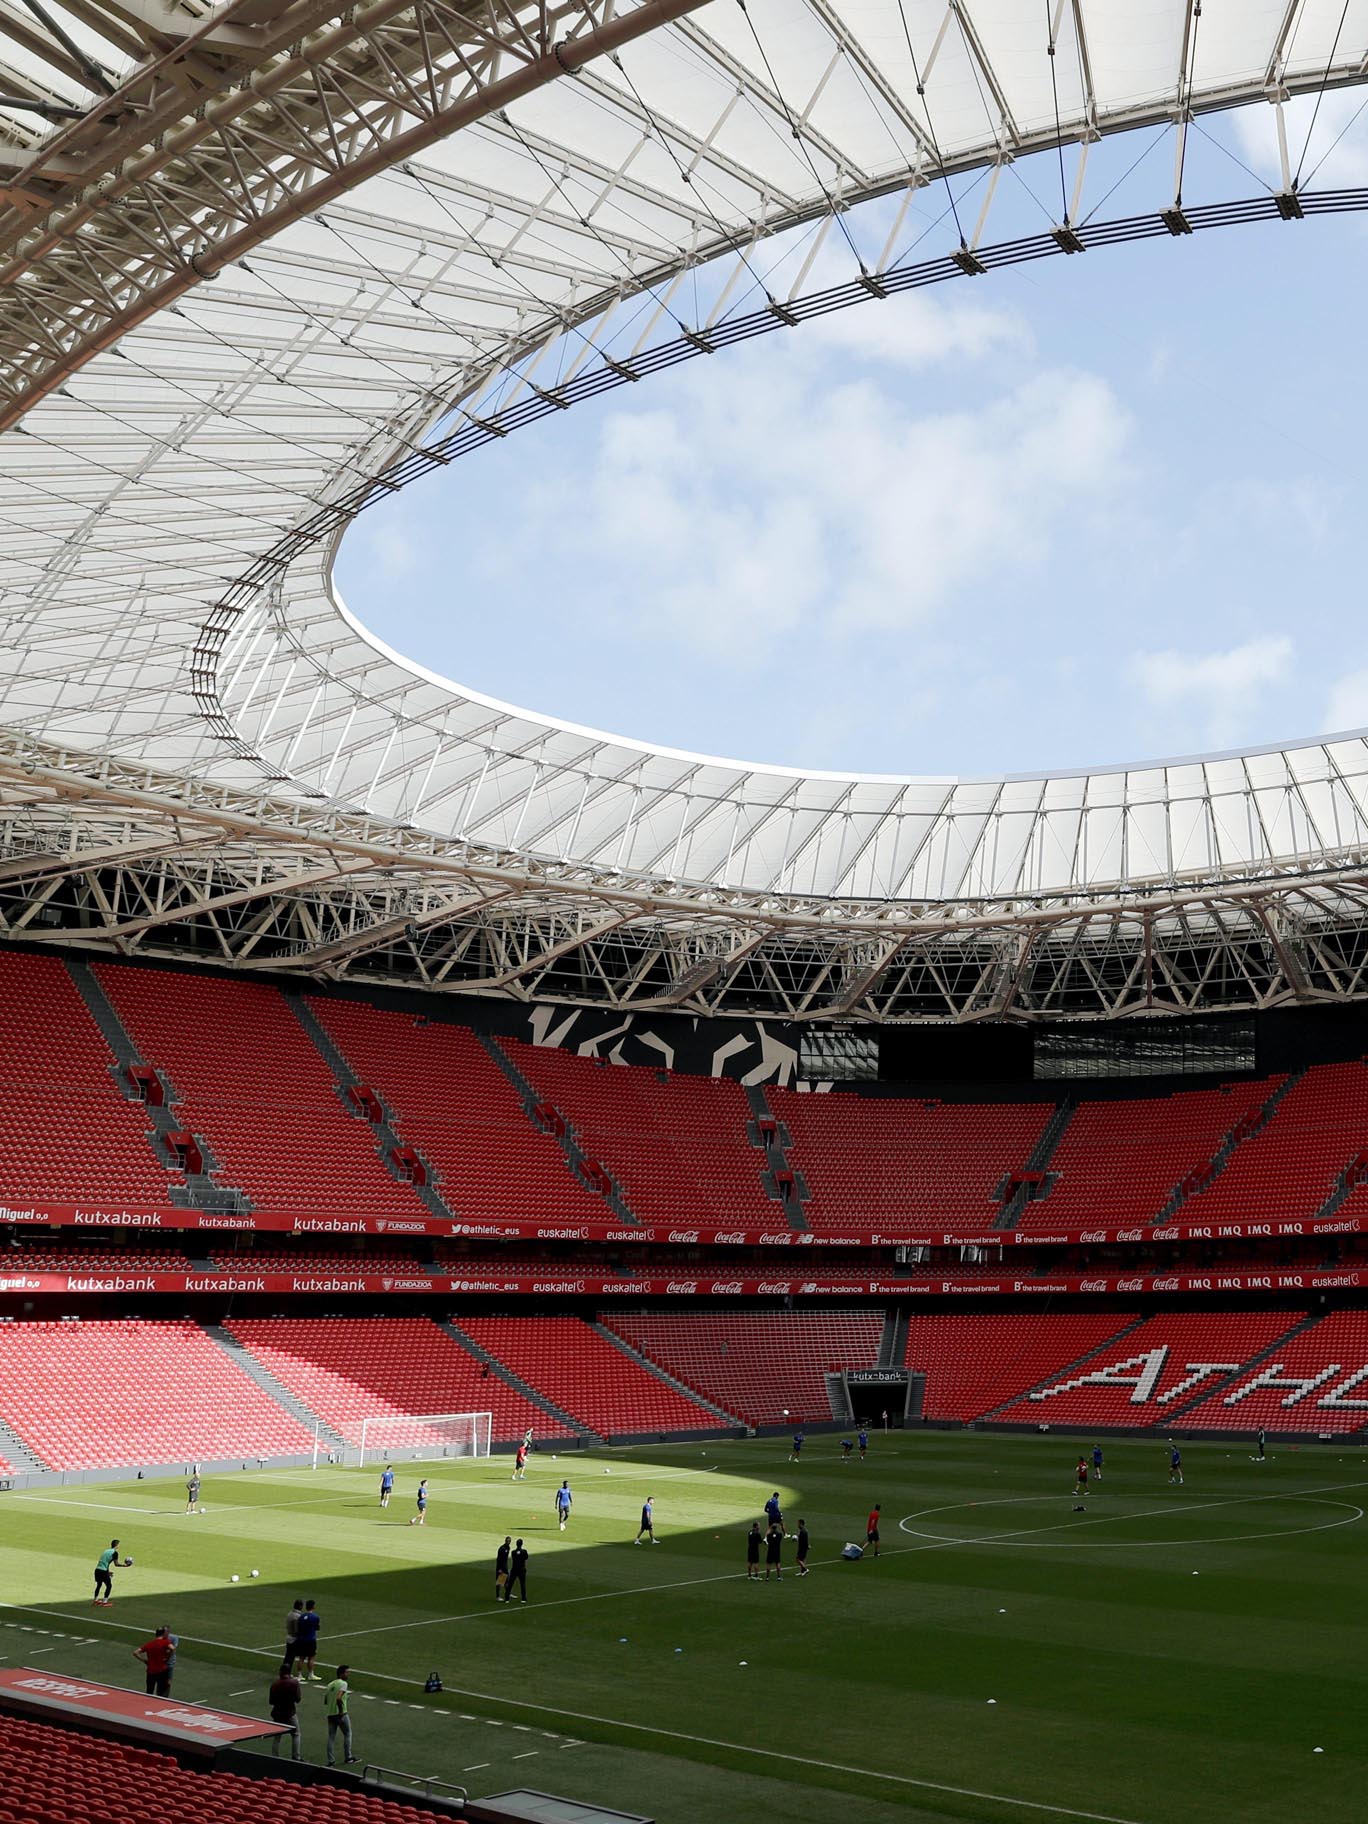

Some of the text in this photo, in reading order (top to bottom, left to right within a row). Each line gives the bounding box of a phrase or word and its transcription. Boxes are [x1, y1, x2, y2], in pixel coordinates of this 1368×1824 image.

[75, 1209, 161, 1226] kutxabank
[199, 1215, 256, 1229] kutxabank
[293, 1217, 367, 1231] kutxabank
[1279, 1223, 1303, 1234] IMQ
[1314, 1221, 1351, 1233] euskaltel
[461, 1225, 519, 1235] @athletic_eus
[538, 1228, 580, 1238] euskaltel
[1189, 1227, 1212, 1237] IMQ
[1219, 1226, 1242, 1236] IMQ
[1248, 1224, 1271, 1235] IMQ
[607, 1231, 646, 1240] euskaltel
[982, 1236, 1001, 1244] brand
[1050, 1235, 1068, 1243] brand
[67, 1276, 156, 1292] kutxabank
[185, 1277, 264, 1290] kutxabank
[293, 1278, 365, 1290] kutxabank
[460, 1281, 518, 1291] @athletic_eus
[1189, 1279, 1211, 1289] IMQ
[1218, 1278, 1241, 1288] IMQ
[1248, 1277, 1271, 1288] IMQ
[1279, 1276, 1303, 1287] IMQ
[1312, 1276, 1350, 1286] euskaltel
[533, 1282, 576, 1292] euskaltel
[603, 1283, 642, 1292] euskaltel
[11, 1678, 109, 1699] RESPECT
